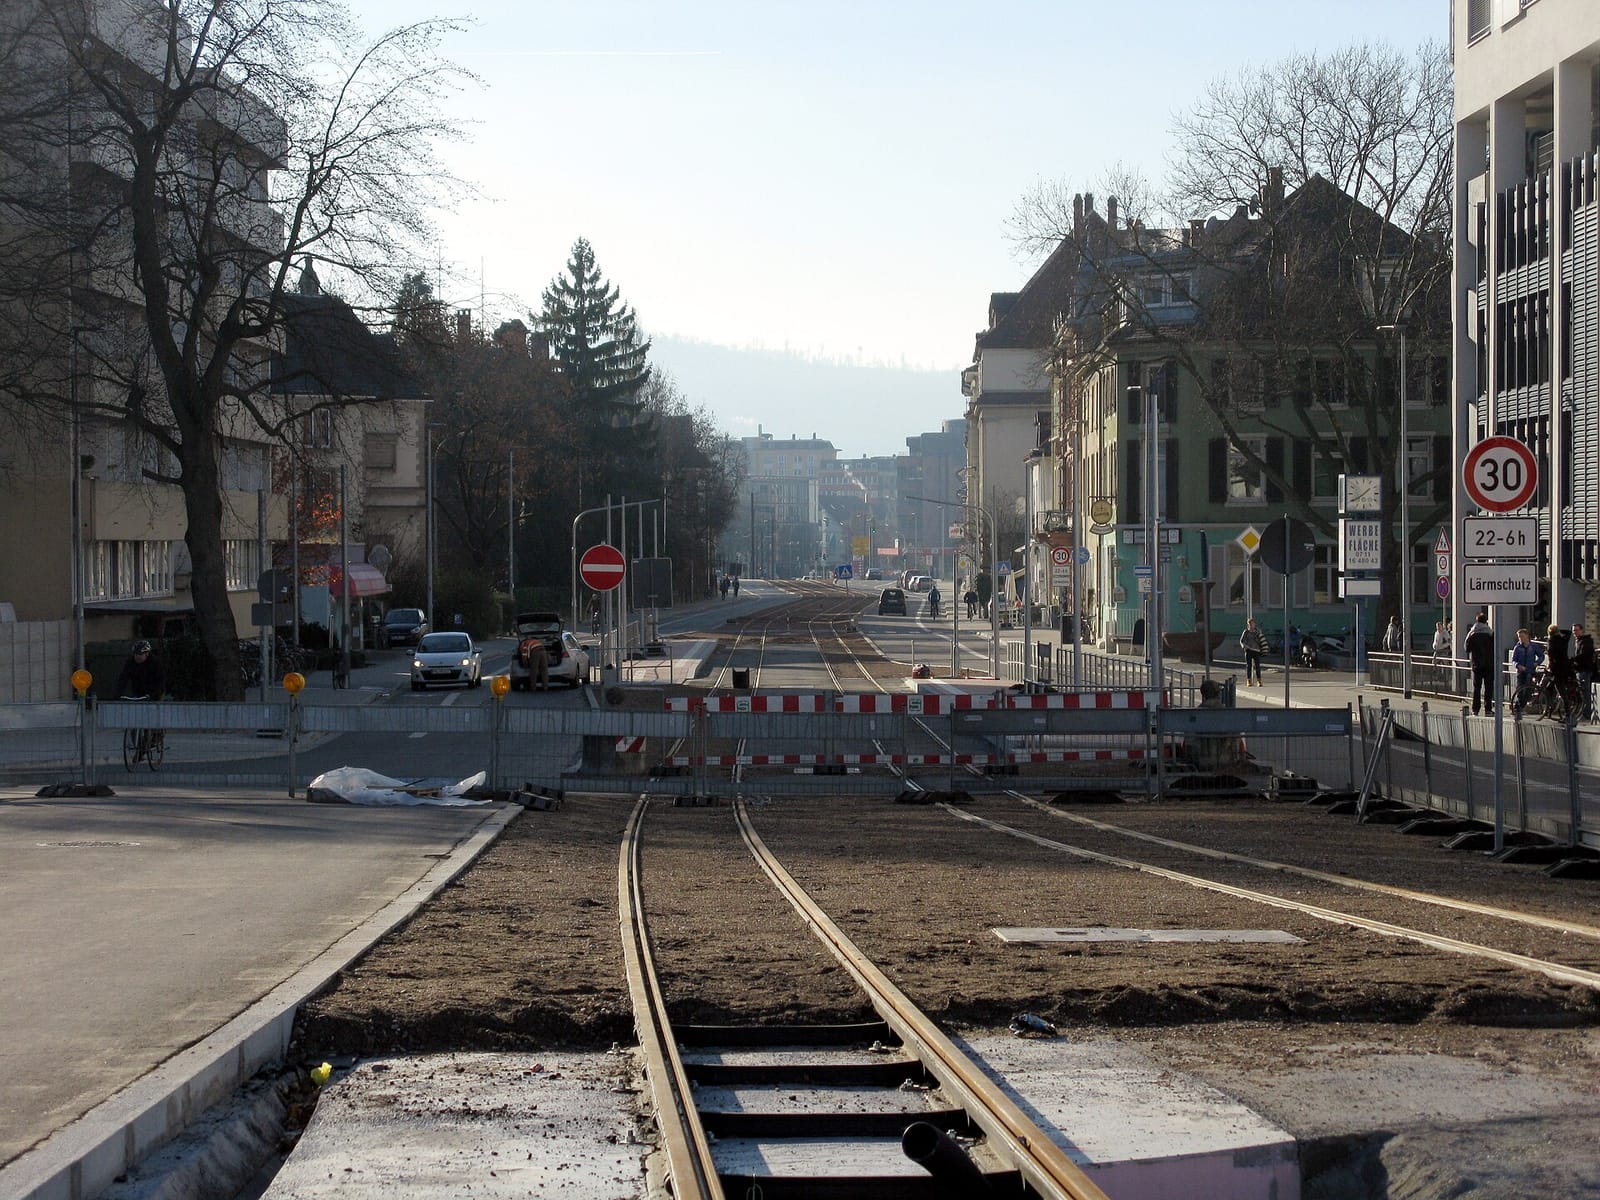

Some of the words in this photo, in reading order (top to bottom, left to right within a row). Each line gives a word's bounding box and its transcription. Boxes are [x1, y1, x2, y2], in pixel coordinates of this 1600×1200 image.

[1480, 458, 1521, 491] 30
[1349, 525, 1378, 536] WERBE
[1349, 539, 1378, 551] FLÄCHE
[1056, 552, 1066, 560] 30
[1469, 577, 1531, 591] Lärmschutz
